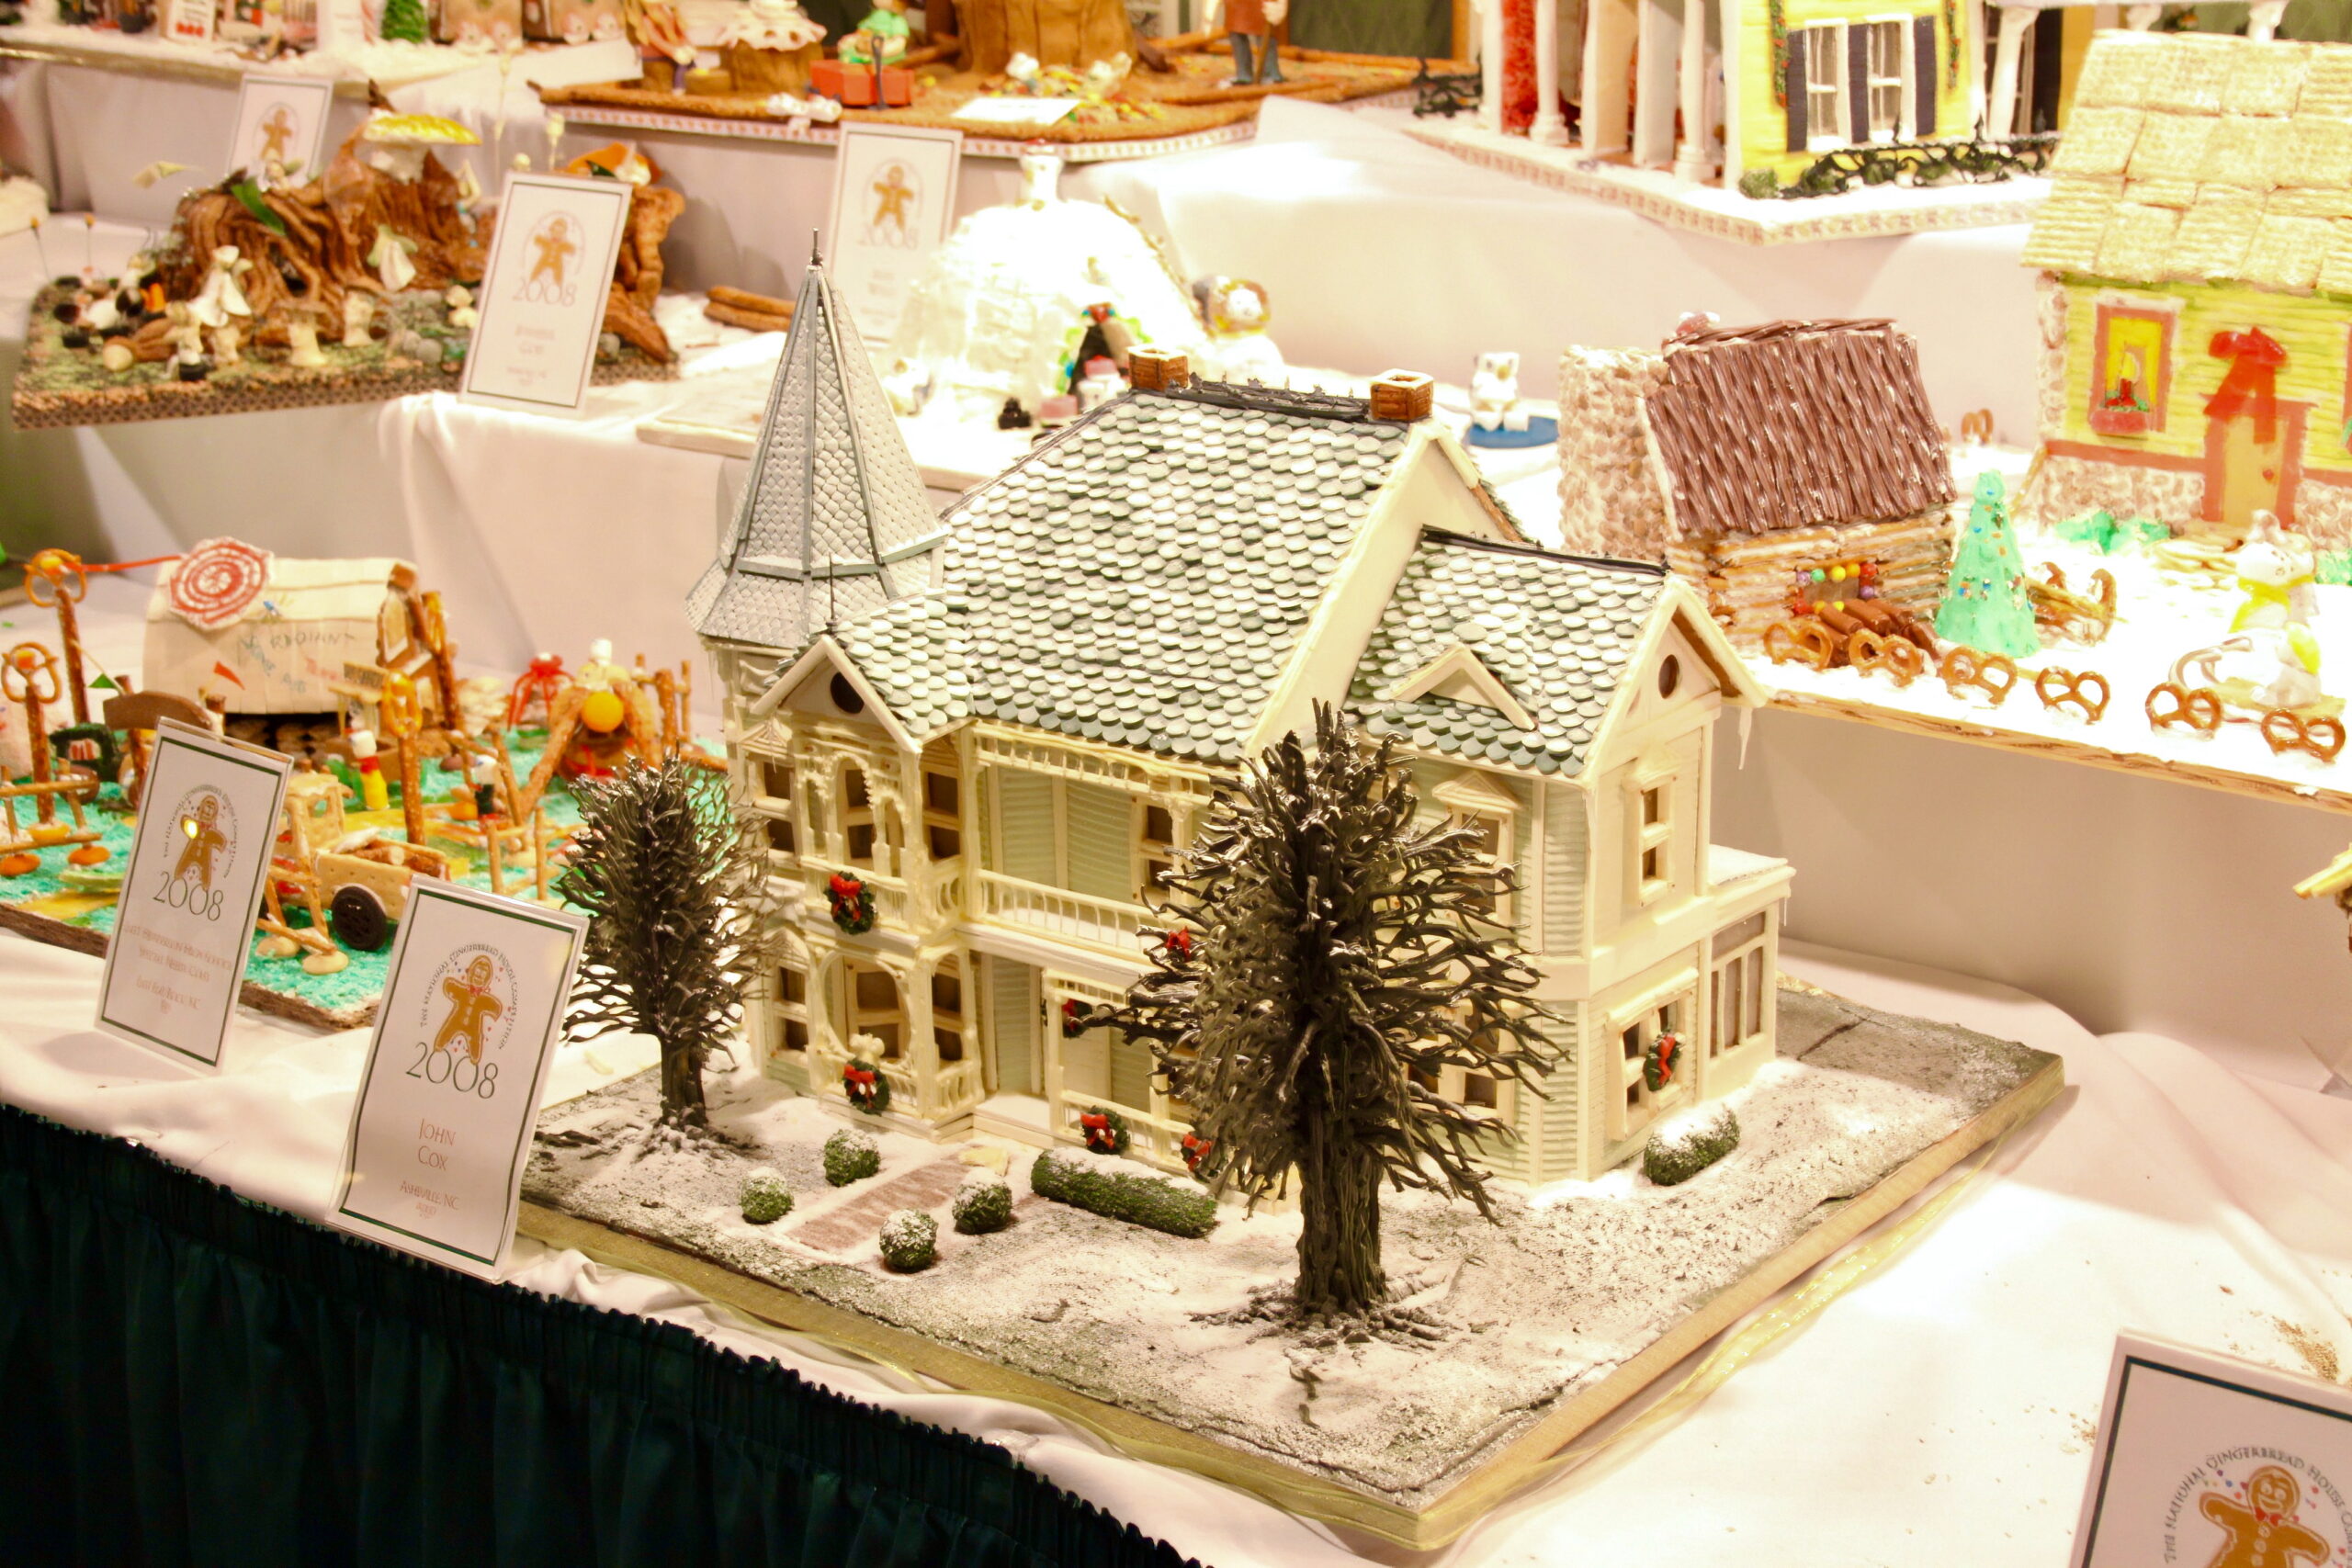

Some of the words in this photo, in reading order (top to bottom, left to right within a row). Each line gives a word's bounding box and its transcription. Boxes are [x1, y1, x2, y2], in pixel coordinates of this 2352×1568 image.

[512, 277, 577, 307] 2008
[152, 871, 224, 921] 2008
[405, 1042, 498, 1100] 2008
[418, 1118, 457, 1147] JOHN
[417, 1145, 448, 1171] COX
[2205, 1446, 2304, 1470] GINGERBREAD
[2165, 1466, 2207, 1529] NATIONAL
[2307, 1465, 2346, 1509] HOUSE
[2164, 1534, 2177, 1563] THE
